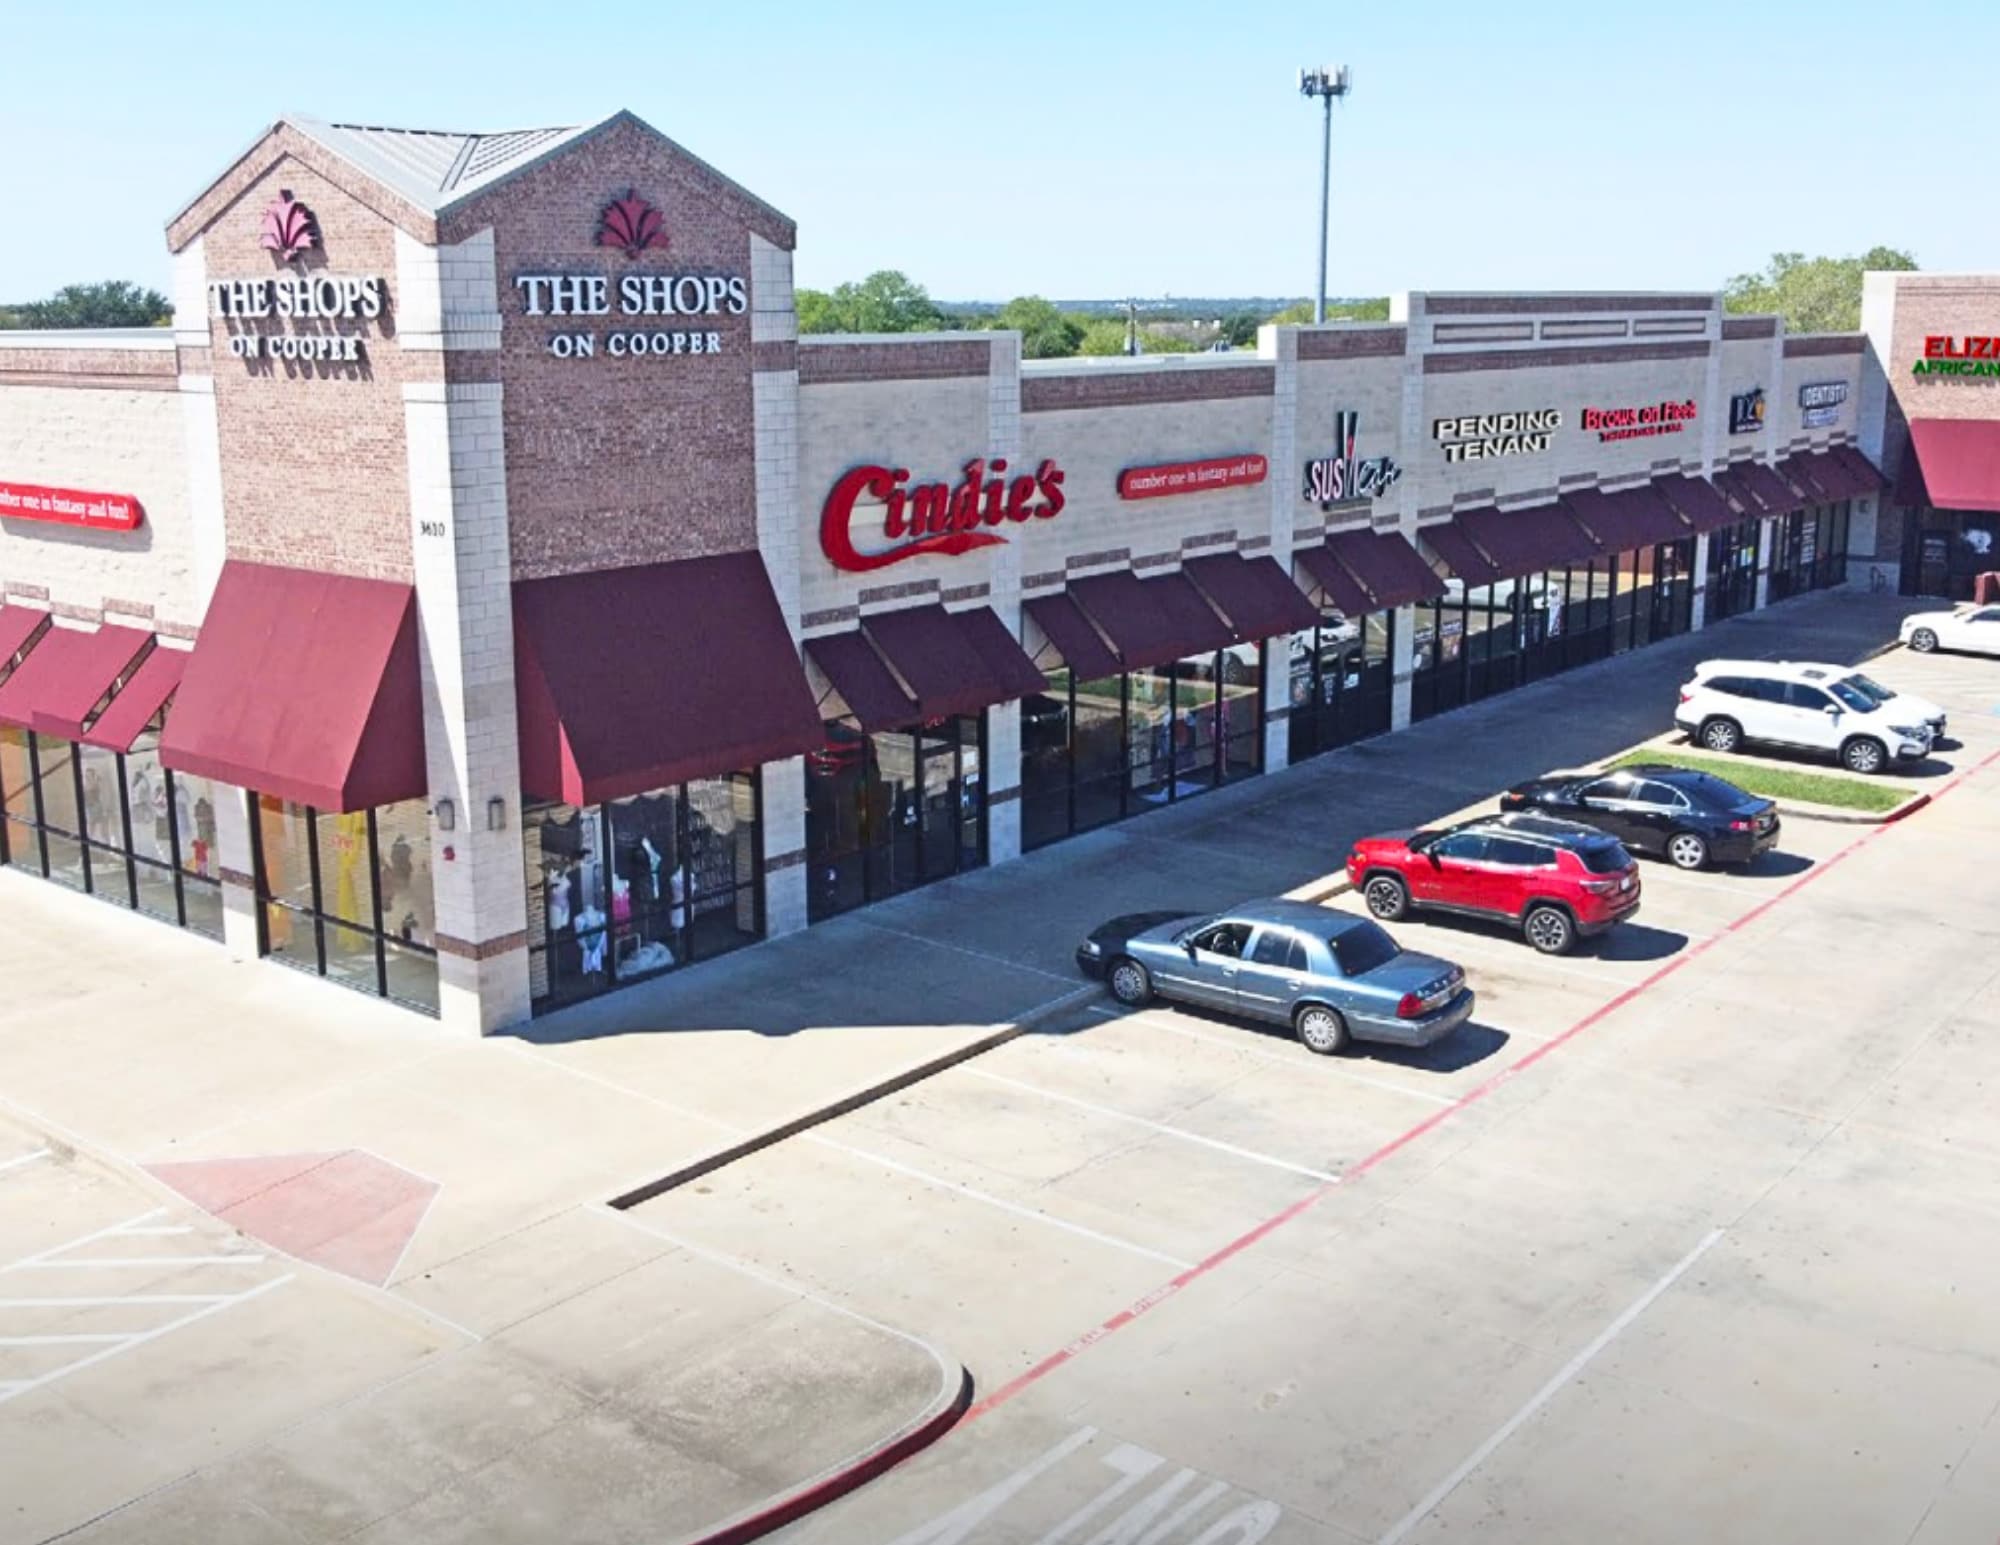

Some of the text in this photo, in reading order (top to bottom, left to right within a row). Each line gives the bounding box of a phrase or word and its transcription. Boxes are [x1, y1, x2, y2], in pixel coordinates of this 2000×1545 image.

[209, 275, 381, 318] THE SHOPS
[516, 274, 748, 316] THE SHOPS
[230, 335, 360, 361] ON COOPER
[552, 332, 721, 358] ON COOPER
[1436, 409, 1562, 440] PENDING
[1444, 432, 1556, 462] TENANT
[820, 458, 1066, 573] Cindie's
